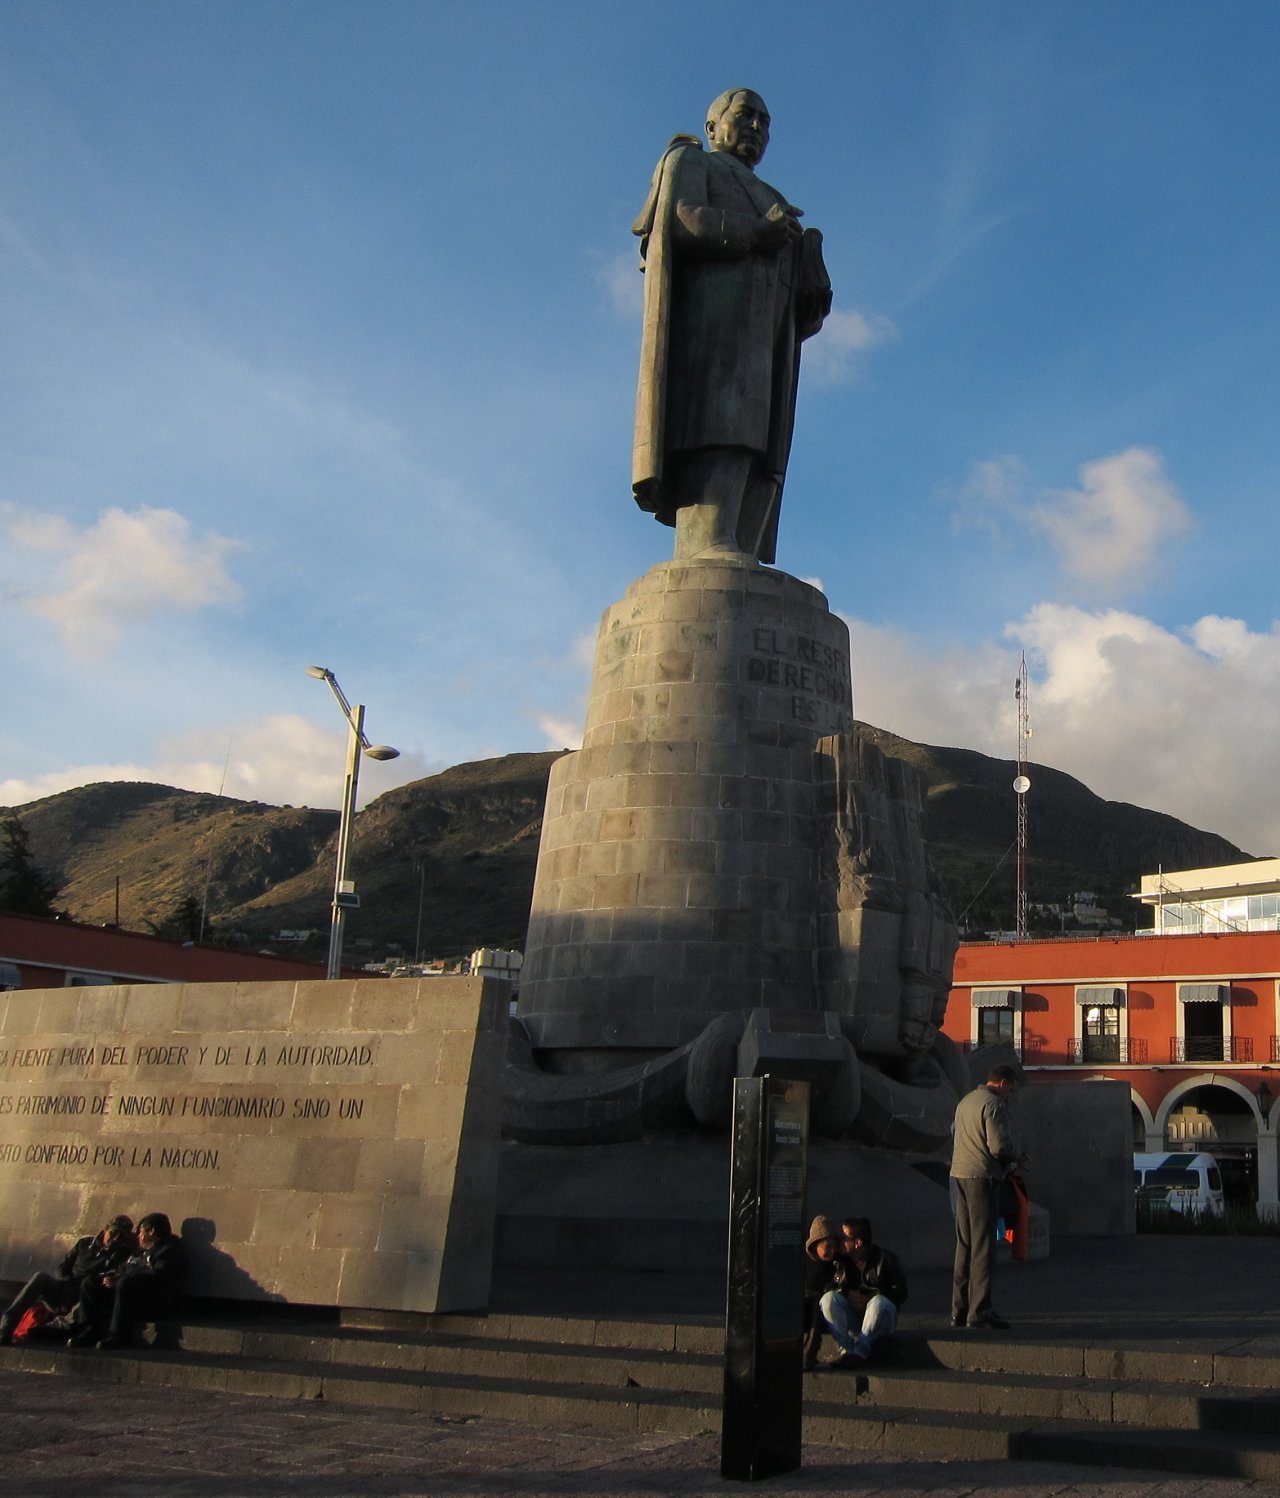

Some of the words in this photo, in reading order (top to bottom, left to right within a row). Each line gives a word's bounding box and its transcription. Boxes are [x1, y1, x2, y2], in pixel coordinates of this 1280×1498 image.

[754, 628, 786, 655] EL
[749, 658, 845, 704] DERECHO
[12, 1048, 57, 1067] FUENTE
[60, 1047, 95, 1066] PURA
[101, 1047, 128, 1065] DEL
[136, 1047, 189, 1065] PODER
[199, 1047, 208, 1065] Y
[215, 1046, 237, 1065] DE
[245, 1046, 267, 1065] LA
[16, 1095, 86, 1115] PATRIMONIO
[91, 1095, 113, 1115] DE
[118, 1095, 175, 1116] NINGUN
[181, 1096, 285, 1118] FUNCIONARIO
[293, 1098, 330, 1119] SINO
[339, 1098, 364, 1119] UN
[25, 1144, 88, 1165] CONFIADO
[93, 1145, 122, 1166] POR
[131, 1147, 152, 1168] LA
[160, 1148, 220, 1170] NACION.
